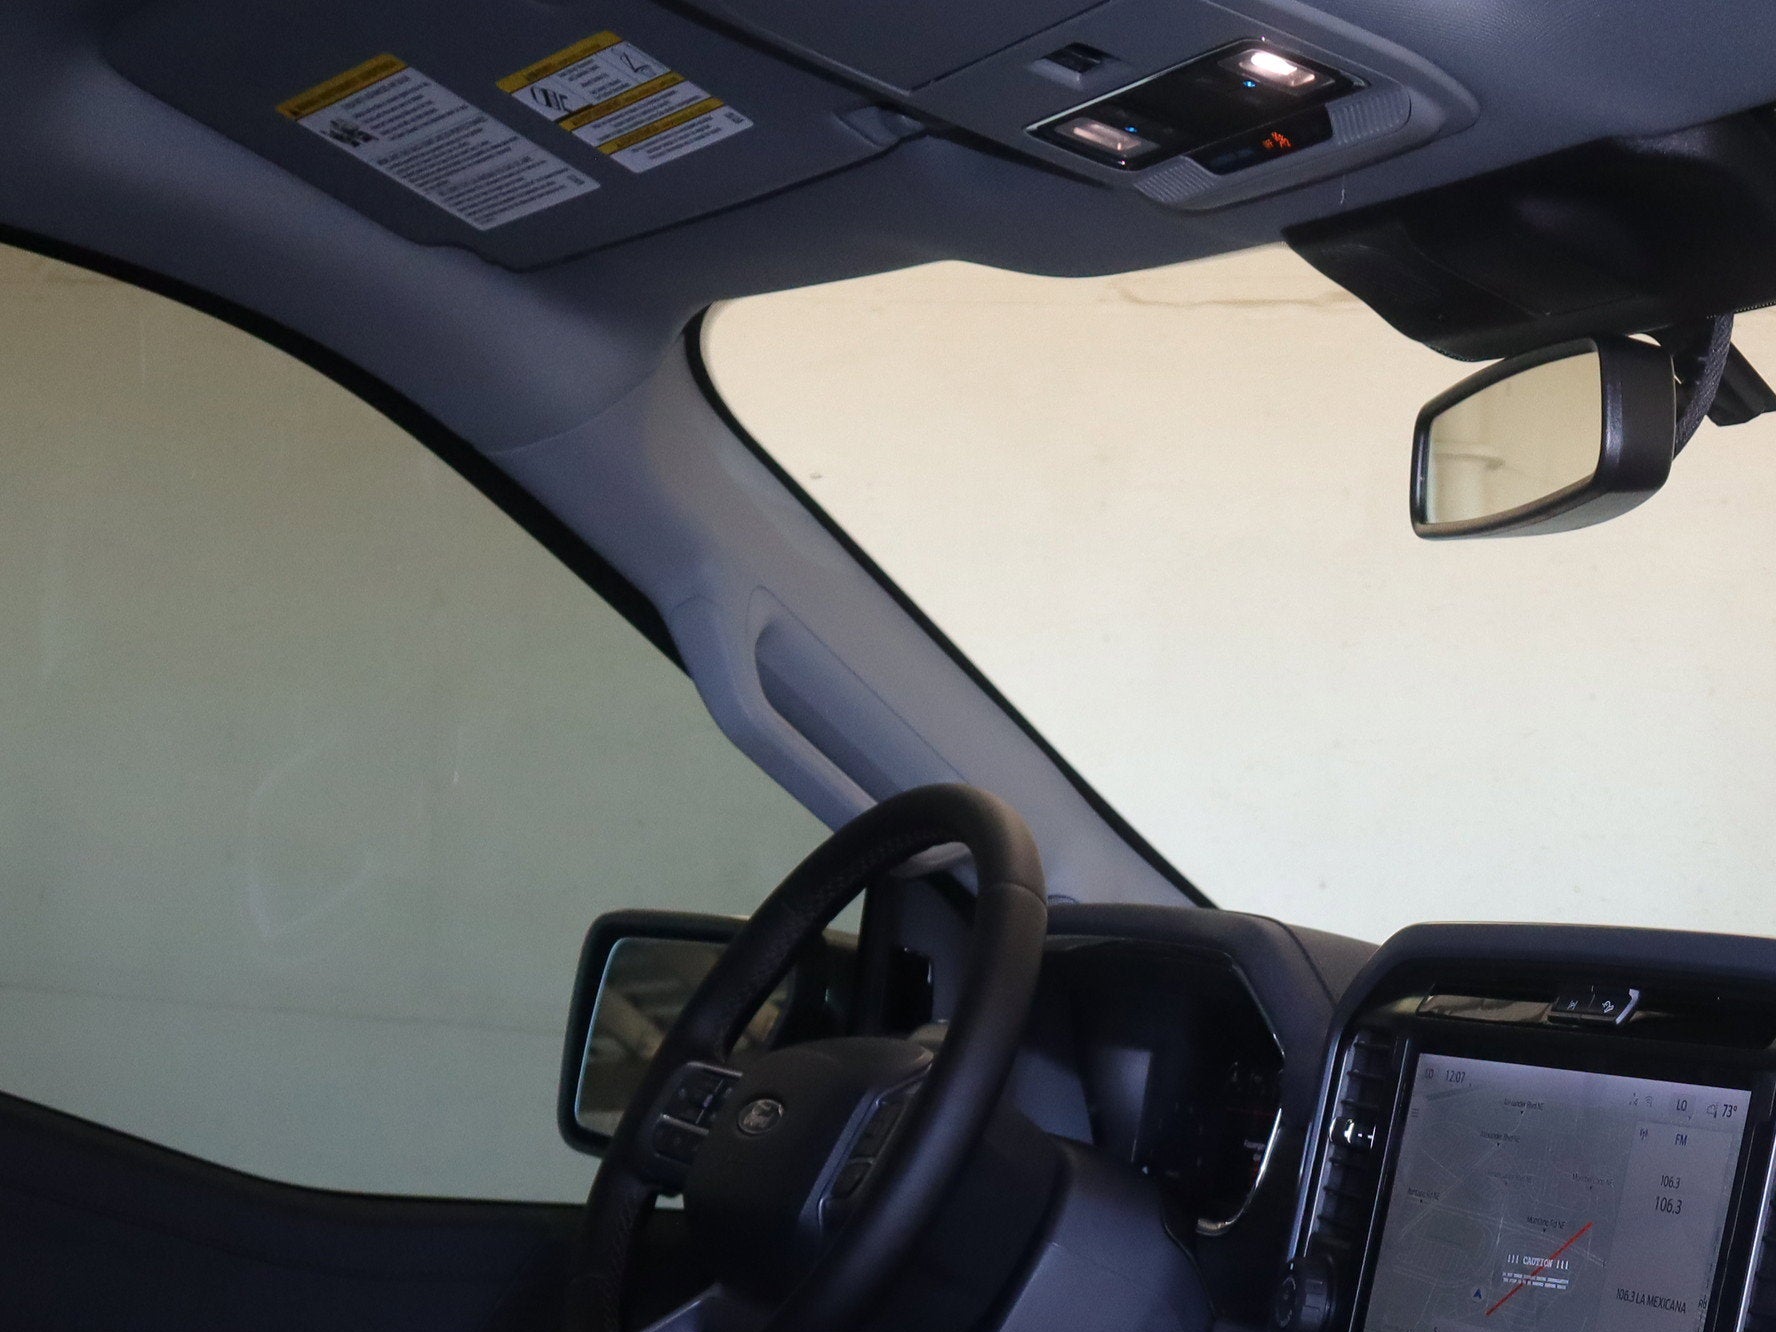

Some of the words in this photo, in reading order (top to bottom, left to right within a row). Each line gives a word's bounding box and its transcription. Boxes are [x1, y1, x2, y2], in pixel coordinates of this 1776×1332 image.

[1445, 1069, 1466, 1084] 12:07
[1676, 1098, 1688, 1112] LO
[1674, 1133, 1688, 1147] FM
[1660, 1175, 1680, 1190] 106.3
[1655, 1196, 1683, 1215] 106.3
[1522, 1255, 1554, 1268] CAUTION
[1616, 1288, 1635, 1303] 106.3
[1635, 1291, 1646, 1305] LA
[1646, 1292, 1687, 1314] MEXICANA
